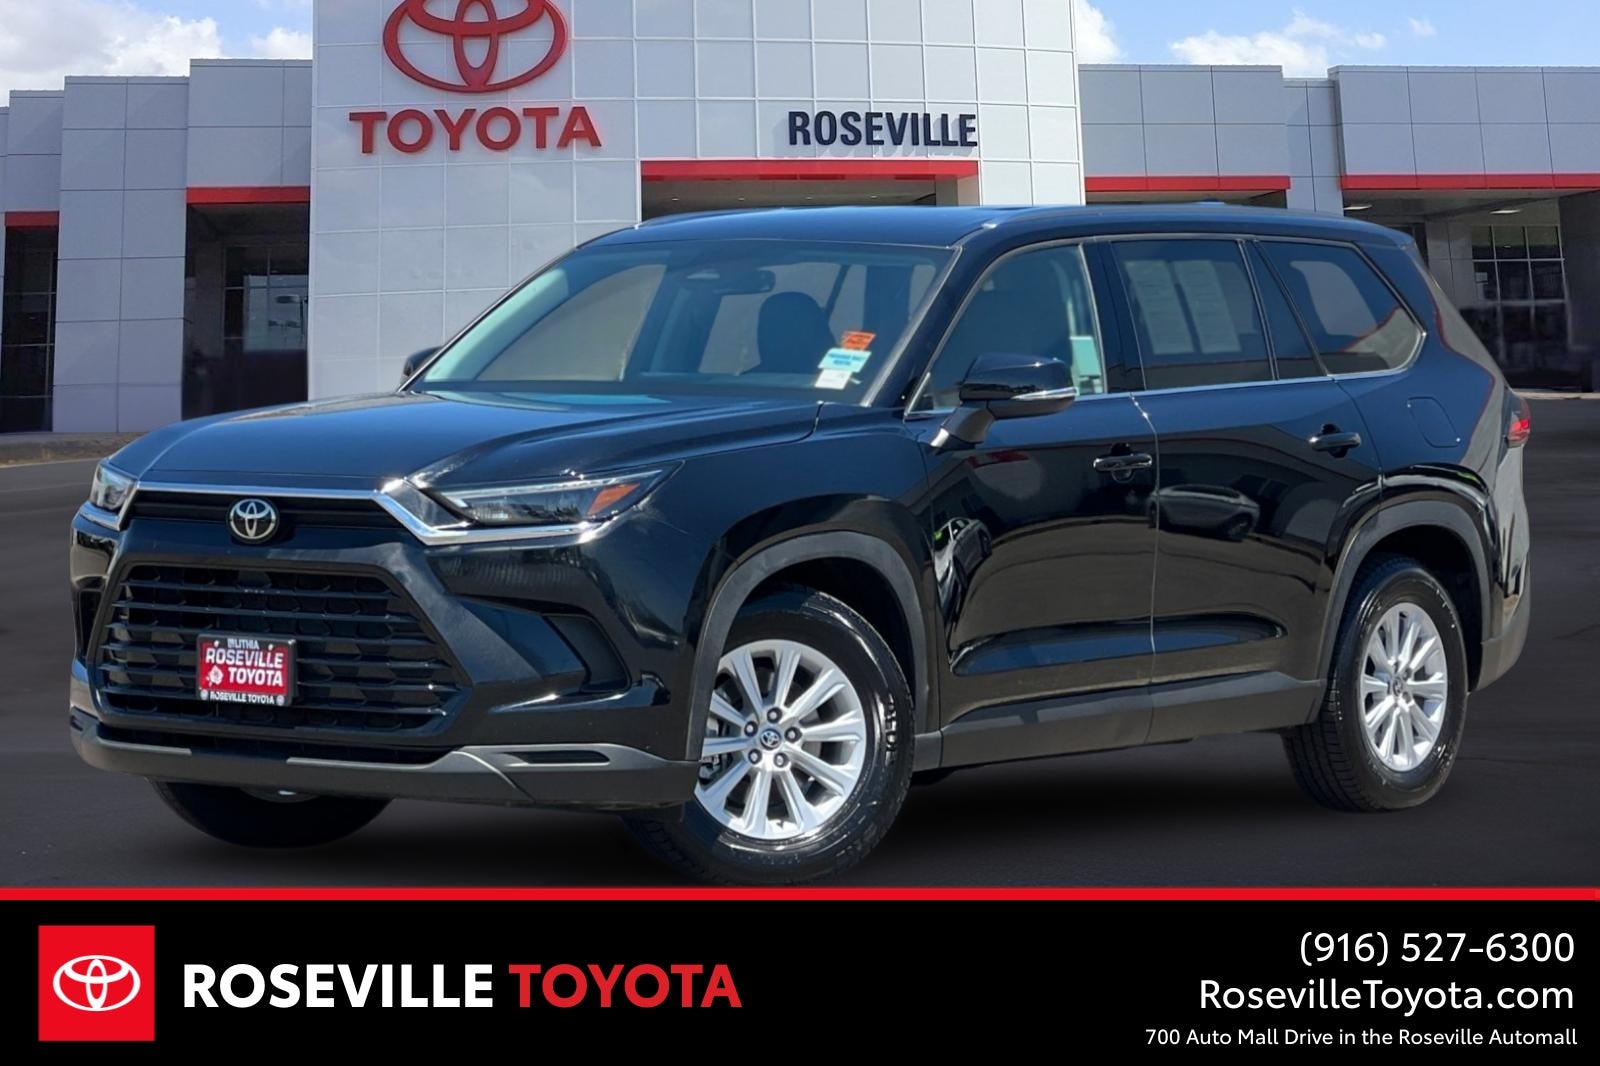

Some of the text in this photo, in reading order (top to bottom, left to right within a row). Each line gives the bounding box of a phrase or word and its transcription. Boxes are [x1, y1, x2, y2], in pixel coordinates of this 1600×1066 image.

[350, 106, 601, 154] TOYOTA
[788, 110, 978, 147] ROSEVILLE
[205, 648, 284, 669] ROSEVILLE
[228, 666, 283, 687] TOYOTA
[210, 691, 275, 705] ROSEVILLE TOYOTA
